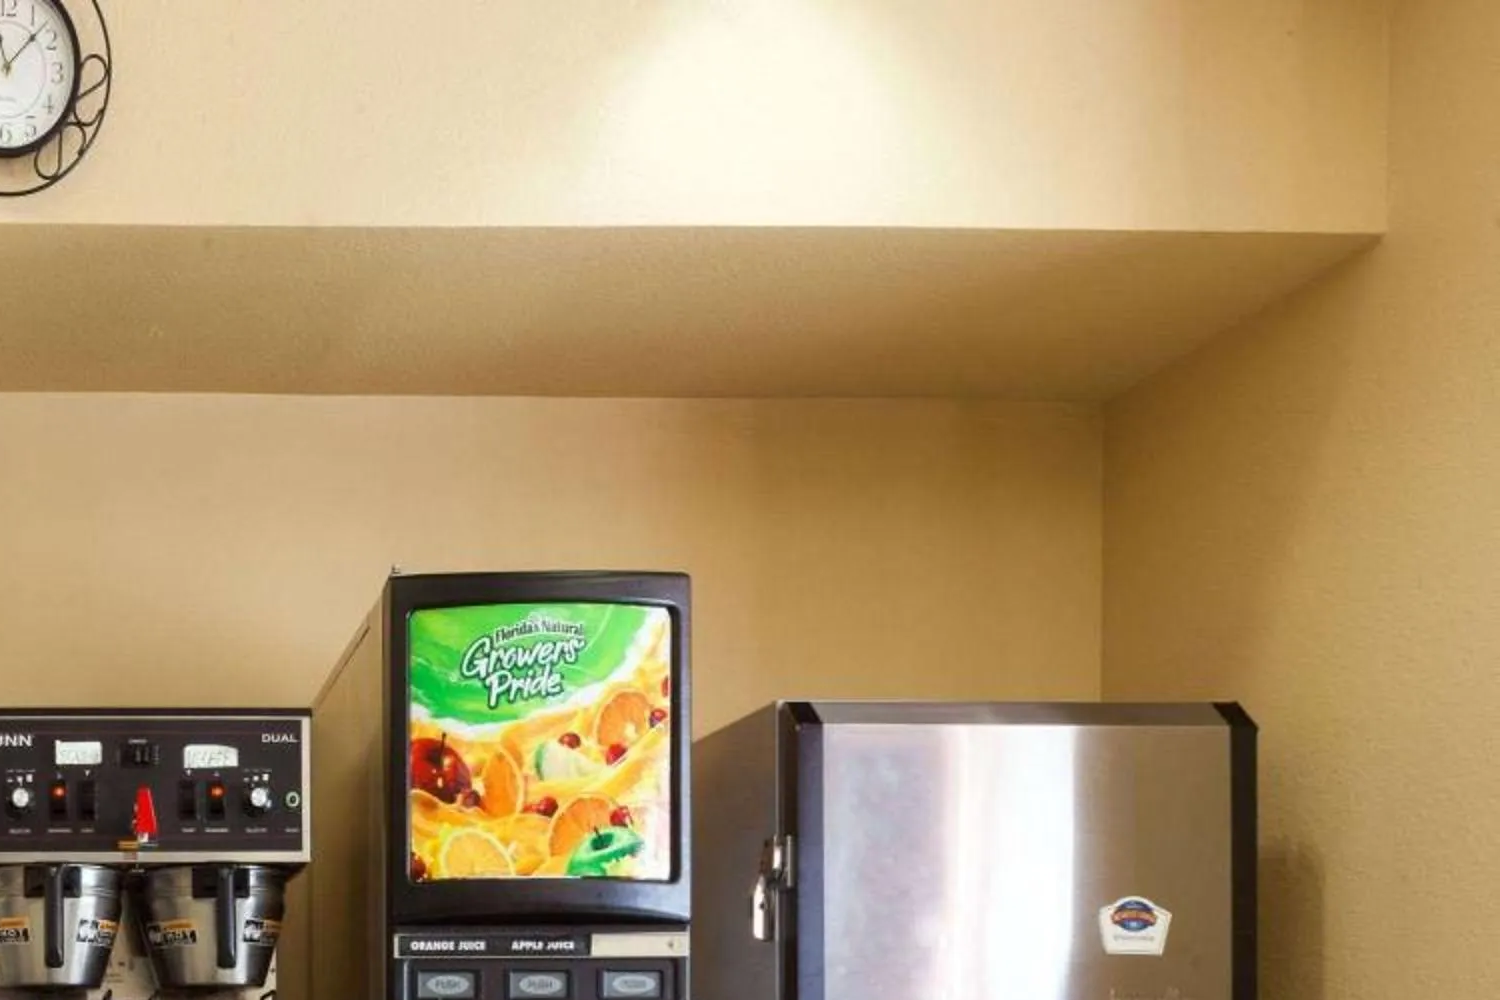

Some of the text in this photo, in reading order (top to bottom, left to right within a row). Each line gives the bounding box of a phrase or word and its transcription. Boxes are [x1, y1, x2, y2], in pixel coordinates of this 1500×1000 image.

[1, 0, 17, 17] 12
[45, 29, 57, 51] 2
[51, 62, 63, 84] 3
[0, 122, 12, 144] 6
[24, 115, 37, 139] 5
[540, 619, 583, 635] Natural
[485, 663, 564, 707] Pride
[261, 733, 298, 743] DUAL
[410, 940, 486, 951] ORANGE JUICE
[511, 940, 575, 950] APPLE JUICE
